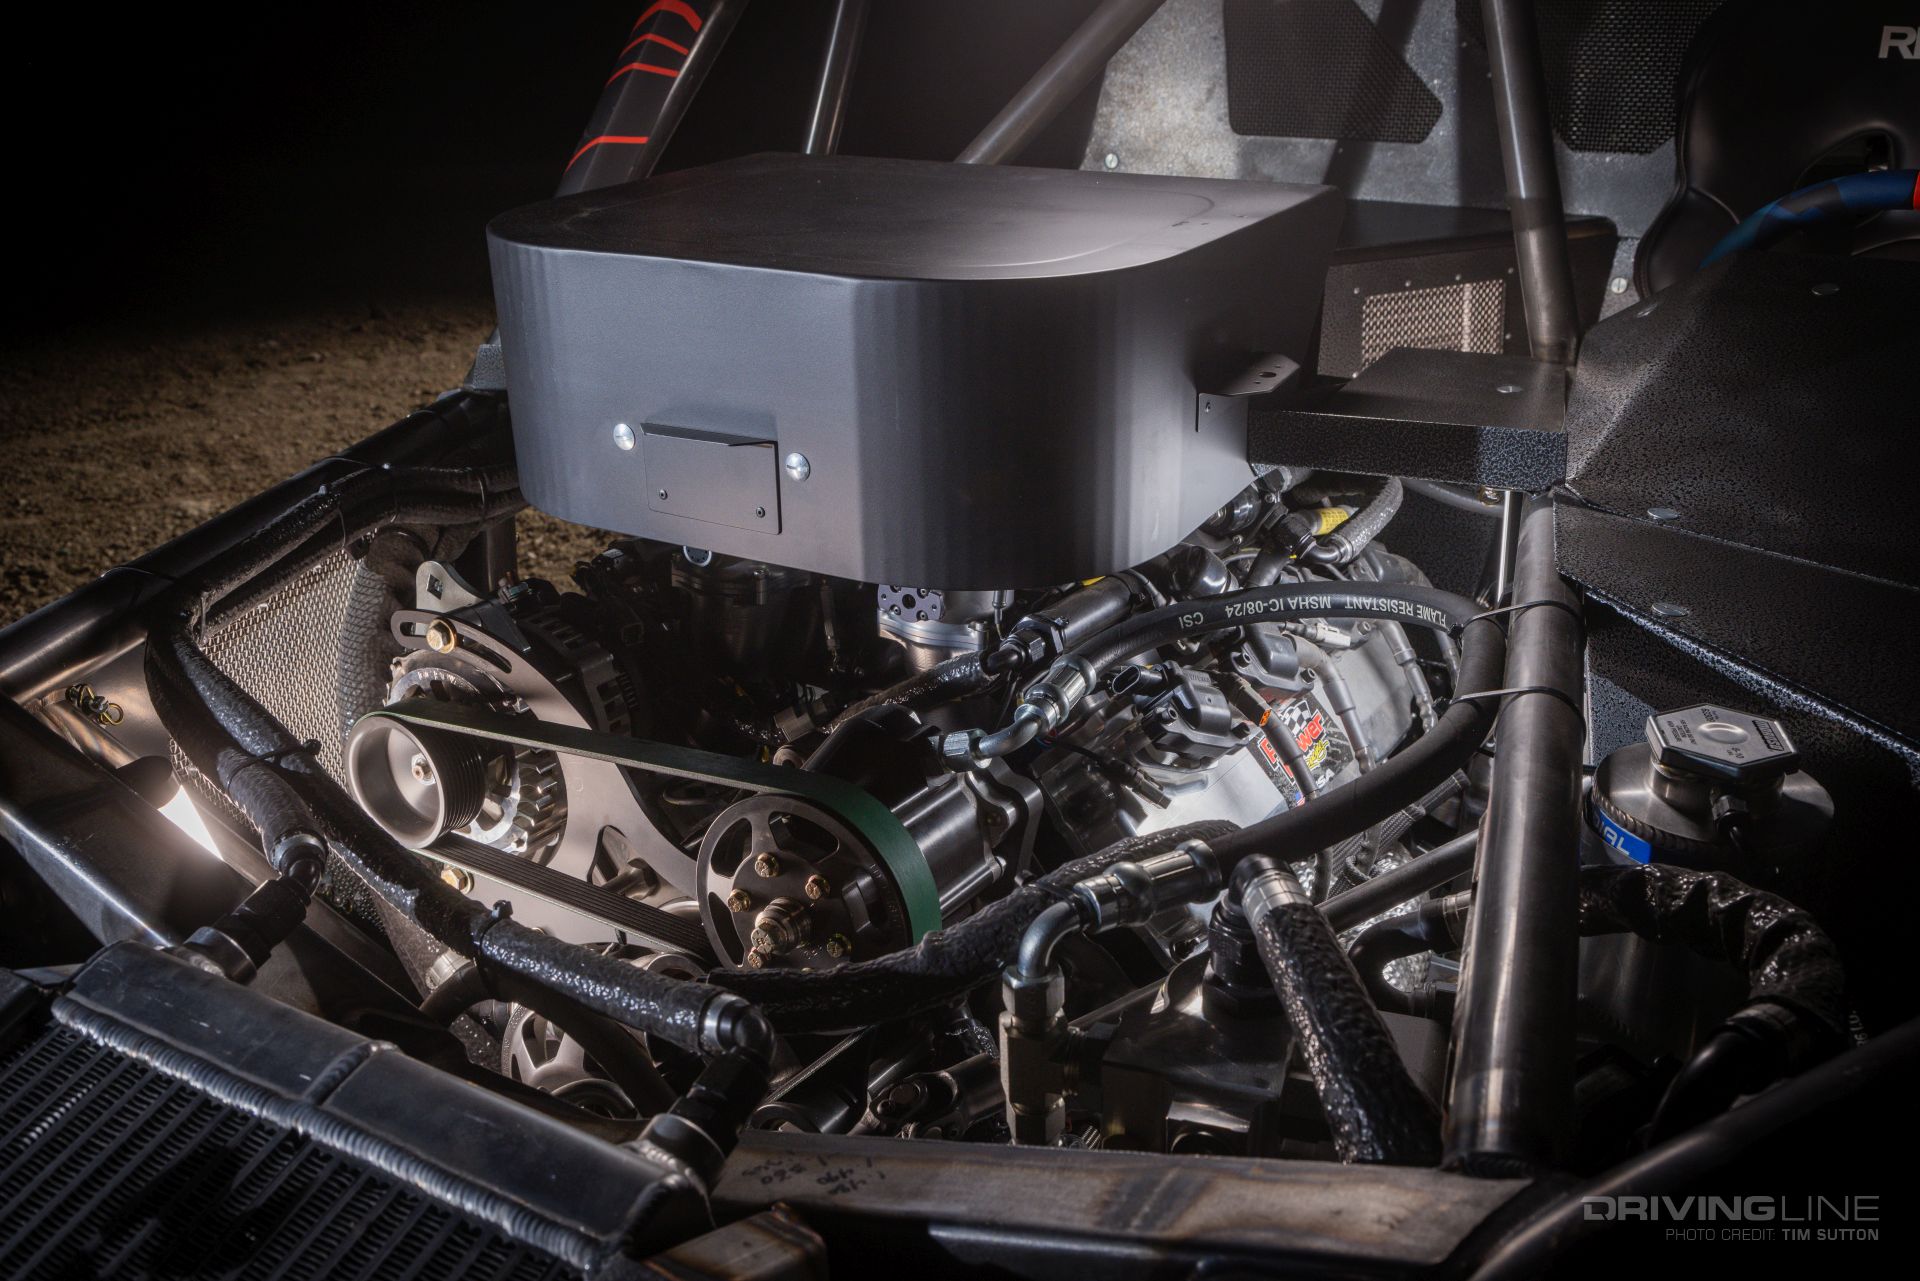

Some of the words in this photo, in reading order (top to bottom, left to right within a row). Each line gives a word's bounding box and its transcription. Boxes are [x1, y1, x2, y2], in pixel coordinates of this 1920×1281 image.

[1225, 598, 1284, 619] IC-08/24
[1287, 595, 1332, 611] MSHA
[1345, 596, 1414, 616] RESISTANT
[1178, 611, 1204, 629] CSI
[1416, 603, 1447, 628] FLAME
